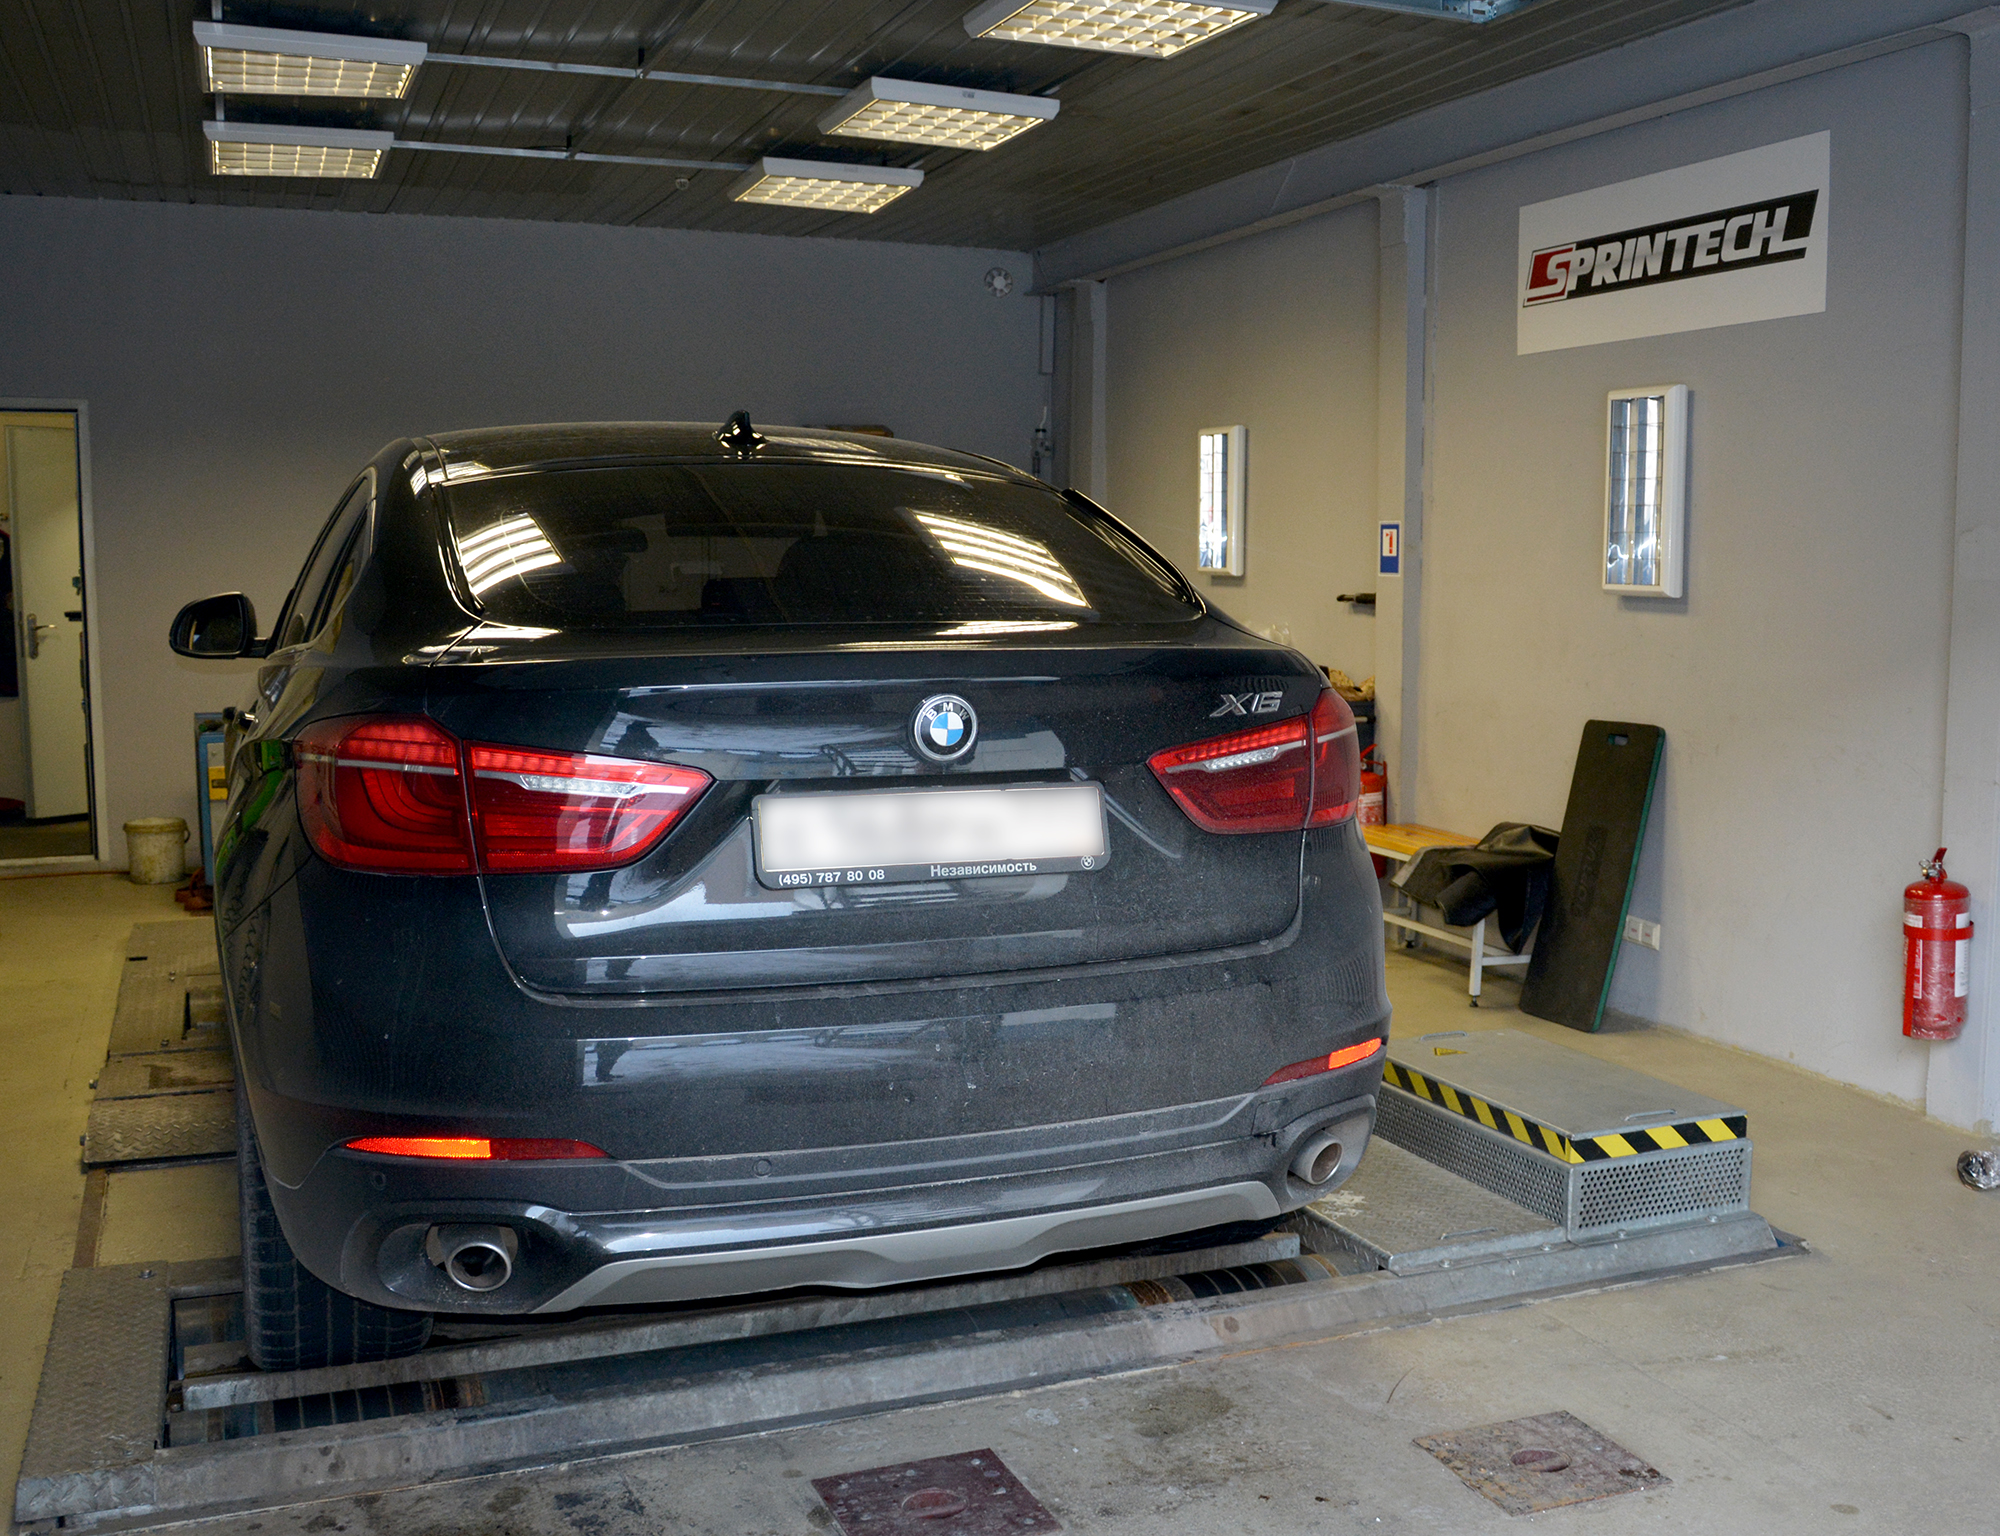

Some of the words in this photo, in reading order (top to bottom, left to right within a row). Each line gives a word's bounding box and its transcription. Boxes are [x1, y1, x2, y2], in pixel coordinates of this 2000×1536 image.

[1524, 203, 1809, 299] SPRINTECH
[925, 701, 970, 721] BMW
[1209, 691, 1284, 718] X6
[778, 872, 813, 887] (495)
[816, 871, 842, 884] 787
[846, 870, 864, 882] 80
[868, 869, 885, 881] 08
[930, 861, 1037, 878] Независимость
